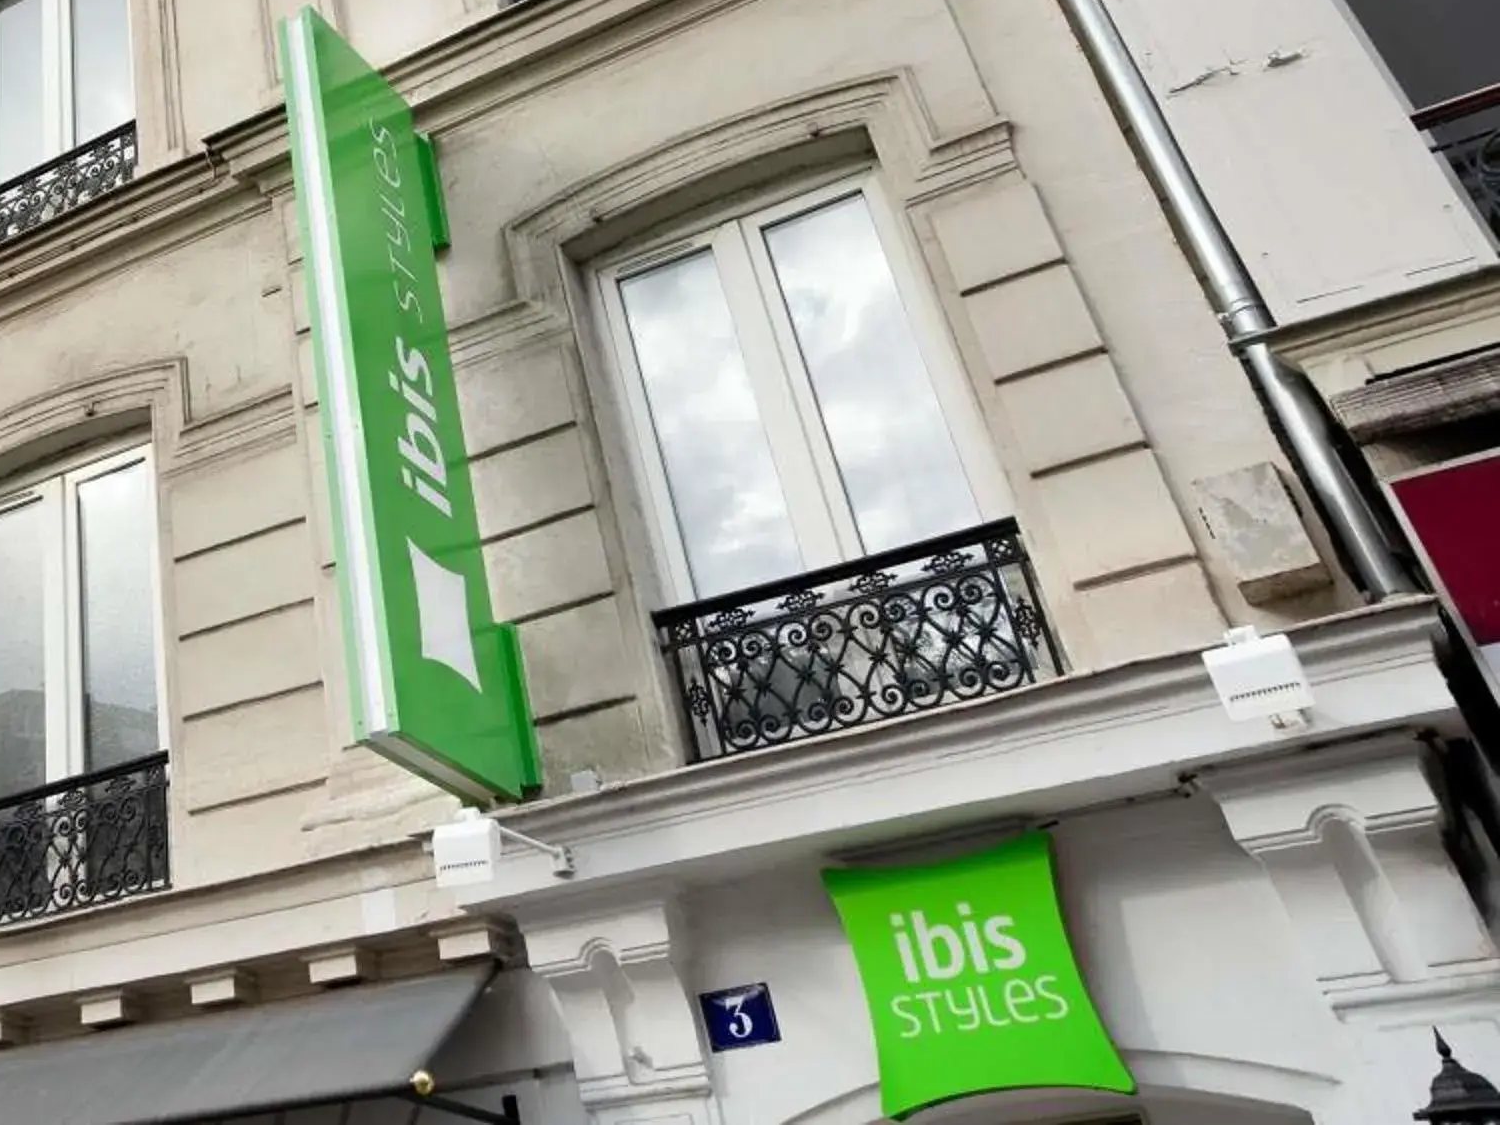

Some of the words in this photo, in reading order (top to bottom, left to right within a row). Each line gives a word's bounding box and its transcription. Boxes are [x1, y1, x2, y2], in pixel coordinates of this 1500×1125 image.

[388, 335, 453, 518] ibis
[889, 901, 1027, 984] ibis
[724, 996, 753, 1038] 3
